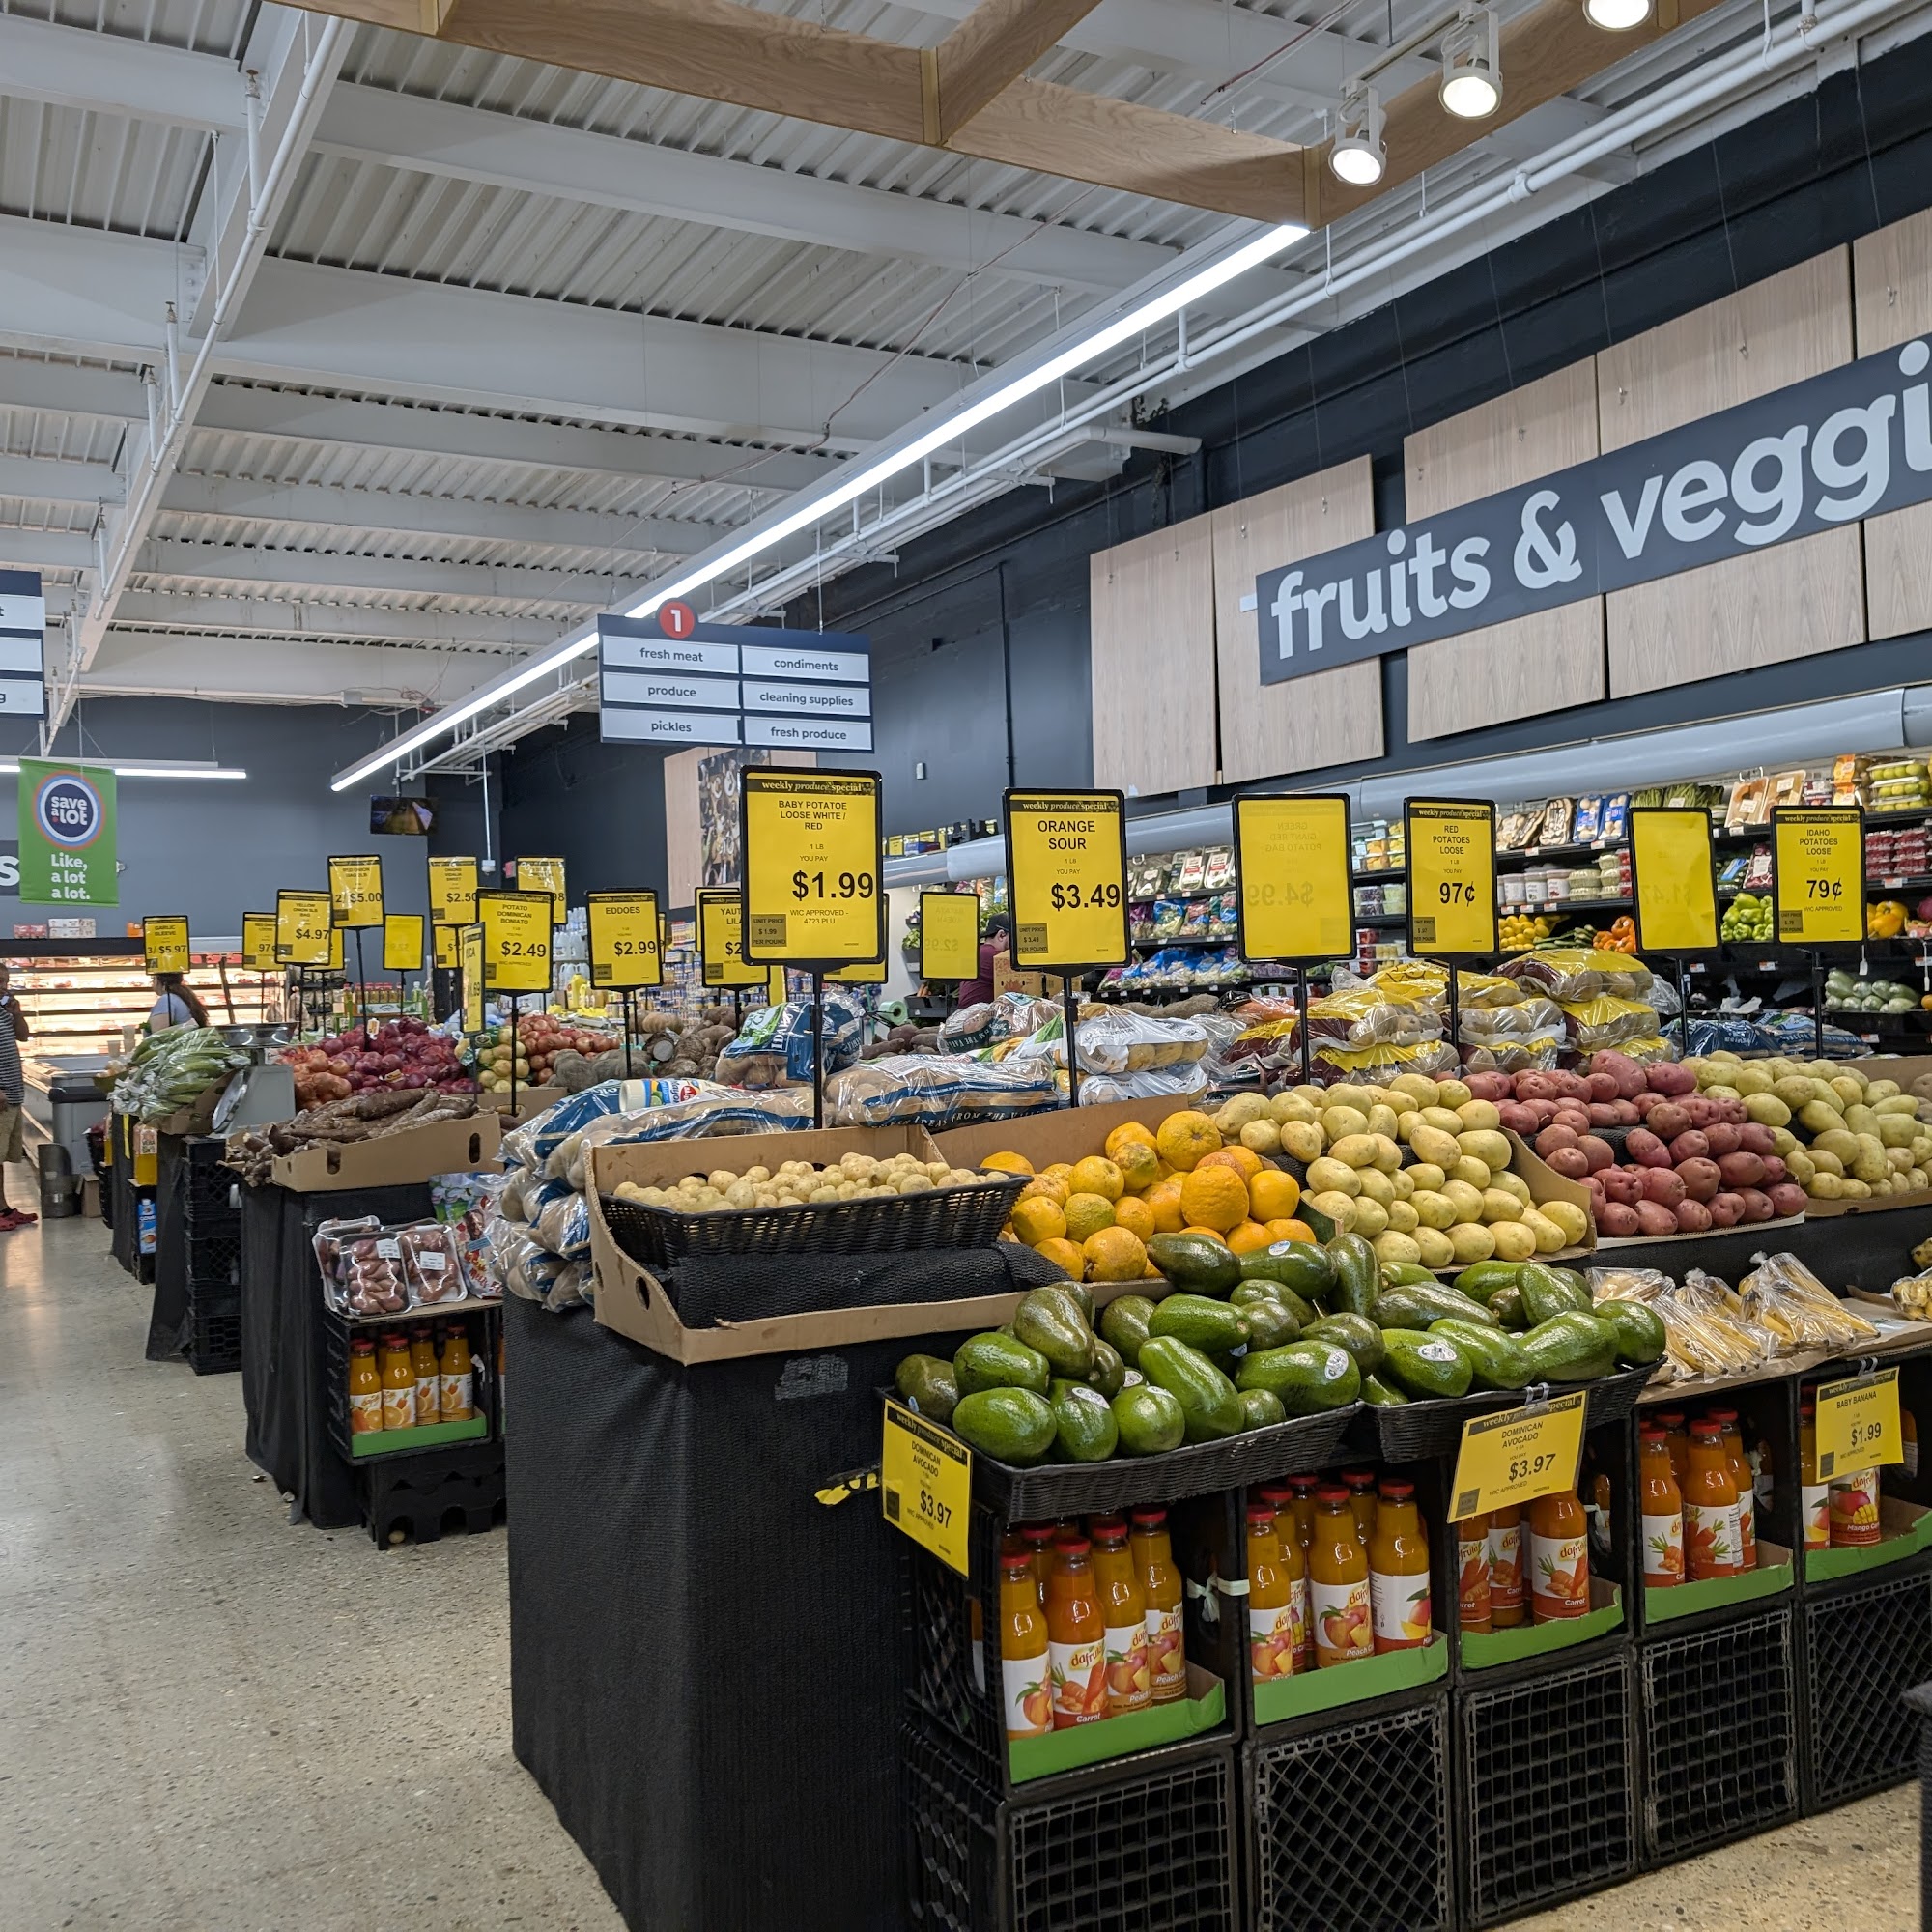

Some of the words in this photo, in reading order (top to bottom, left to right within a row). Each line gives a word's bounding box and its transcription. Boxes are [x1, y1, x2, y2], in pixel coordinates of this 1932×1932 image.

[1270, 527, 1491, 660] fruits
[1513, 489, 1582, 589] &
[670, 609, 682, 632] 1
[639, 647, 670, 661] fresh
[674, 651, 703, 663] meat
[774, 659, 838, 671] condiments
[648, 686, 696, 697] produce
[759, 692, 806, 705] cleaning
[810, 696, 854, 707] supplies
[651, 721, 692, 732] pickles
[771, 726, 799, 738] fresh
[802, 728, 846, 741] produce
[762, 781, 793, 791] weekly
[831, 782, 862, 792] special
[51, 796, 87, 810] save
[1023, 802, 1048, 810] weekly
[1081, 803, 1107, 811] special
[1038, 821, 1095, 833] ORANGE
[1048, 838, 1087, 850] SOUR
[51, 852, 88, 871] Like,
[51, 874, 61, 883] a
[64, 870, 85, 884] lot
[51, 890, 61, 899] a
[64, 887, 91, 899] lot.
[792, 870, 873, 901] $1.99
[1806, 878, 1842, 900] 79¢
[350, 893, 382, 903] $5.00
[1051, 883, 1120, 911] $3.49
[1439, 881, 1475, 907] 97¢
[296, 929, 329, 940] $4.97
[158, 945, 186, 953] $5.97
[501, 941, 546, 957] $2.49
[614, 941, 656, 956] $2.99
[1837, 1398, 1852, 1408] BABY
[1854, 1391, 1877, 1404] BANANA
[1483, 1413, 1511, 1427] weekly
[1547, 1397, 1576, 1412] special
[896, 1413, 917, 1432] weekly
[1502, 1422, 1543, 1438] DOMINICAN
[1502, 1433, 1539, 1448] AVOCADO
[1851, 1422, 1882, 1447] $1.99
[911, 1440, 941, 1466] DOMINICAN
[913, 1454, 939, 1477] AVOCADO
[1509, 1453, 1556, 1482] $3.97
[1501, 1481, 1527, 1493] APPROVED
[921, 1490, 952, 1529] $3.97
[1346, 1647, 1367, 1656] Peach
[1156, 1674, 1178, 1683] Peach
[1076, 1713, 1100, 1723] Carrot
